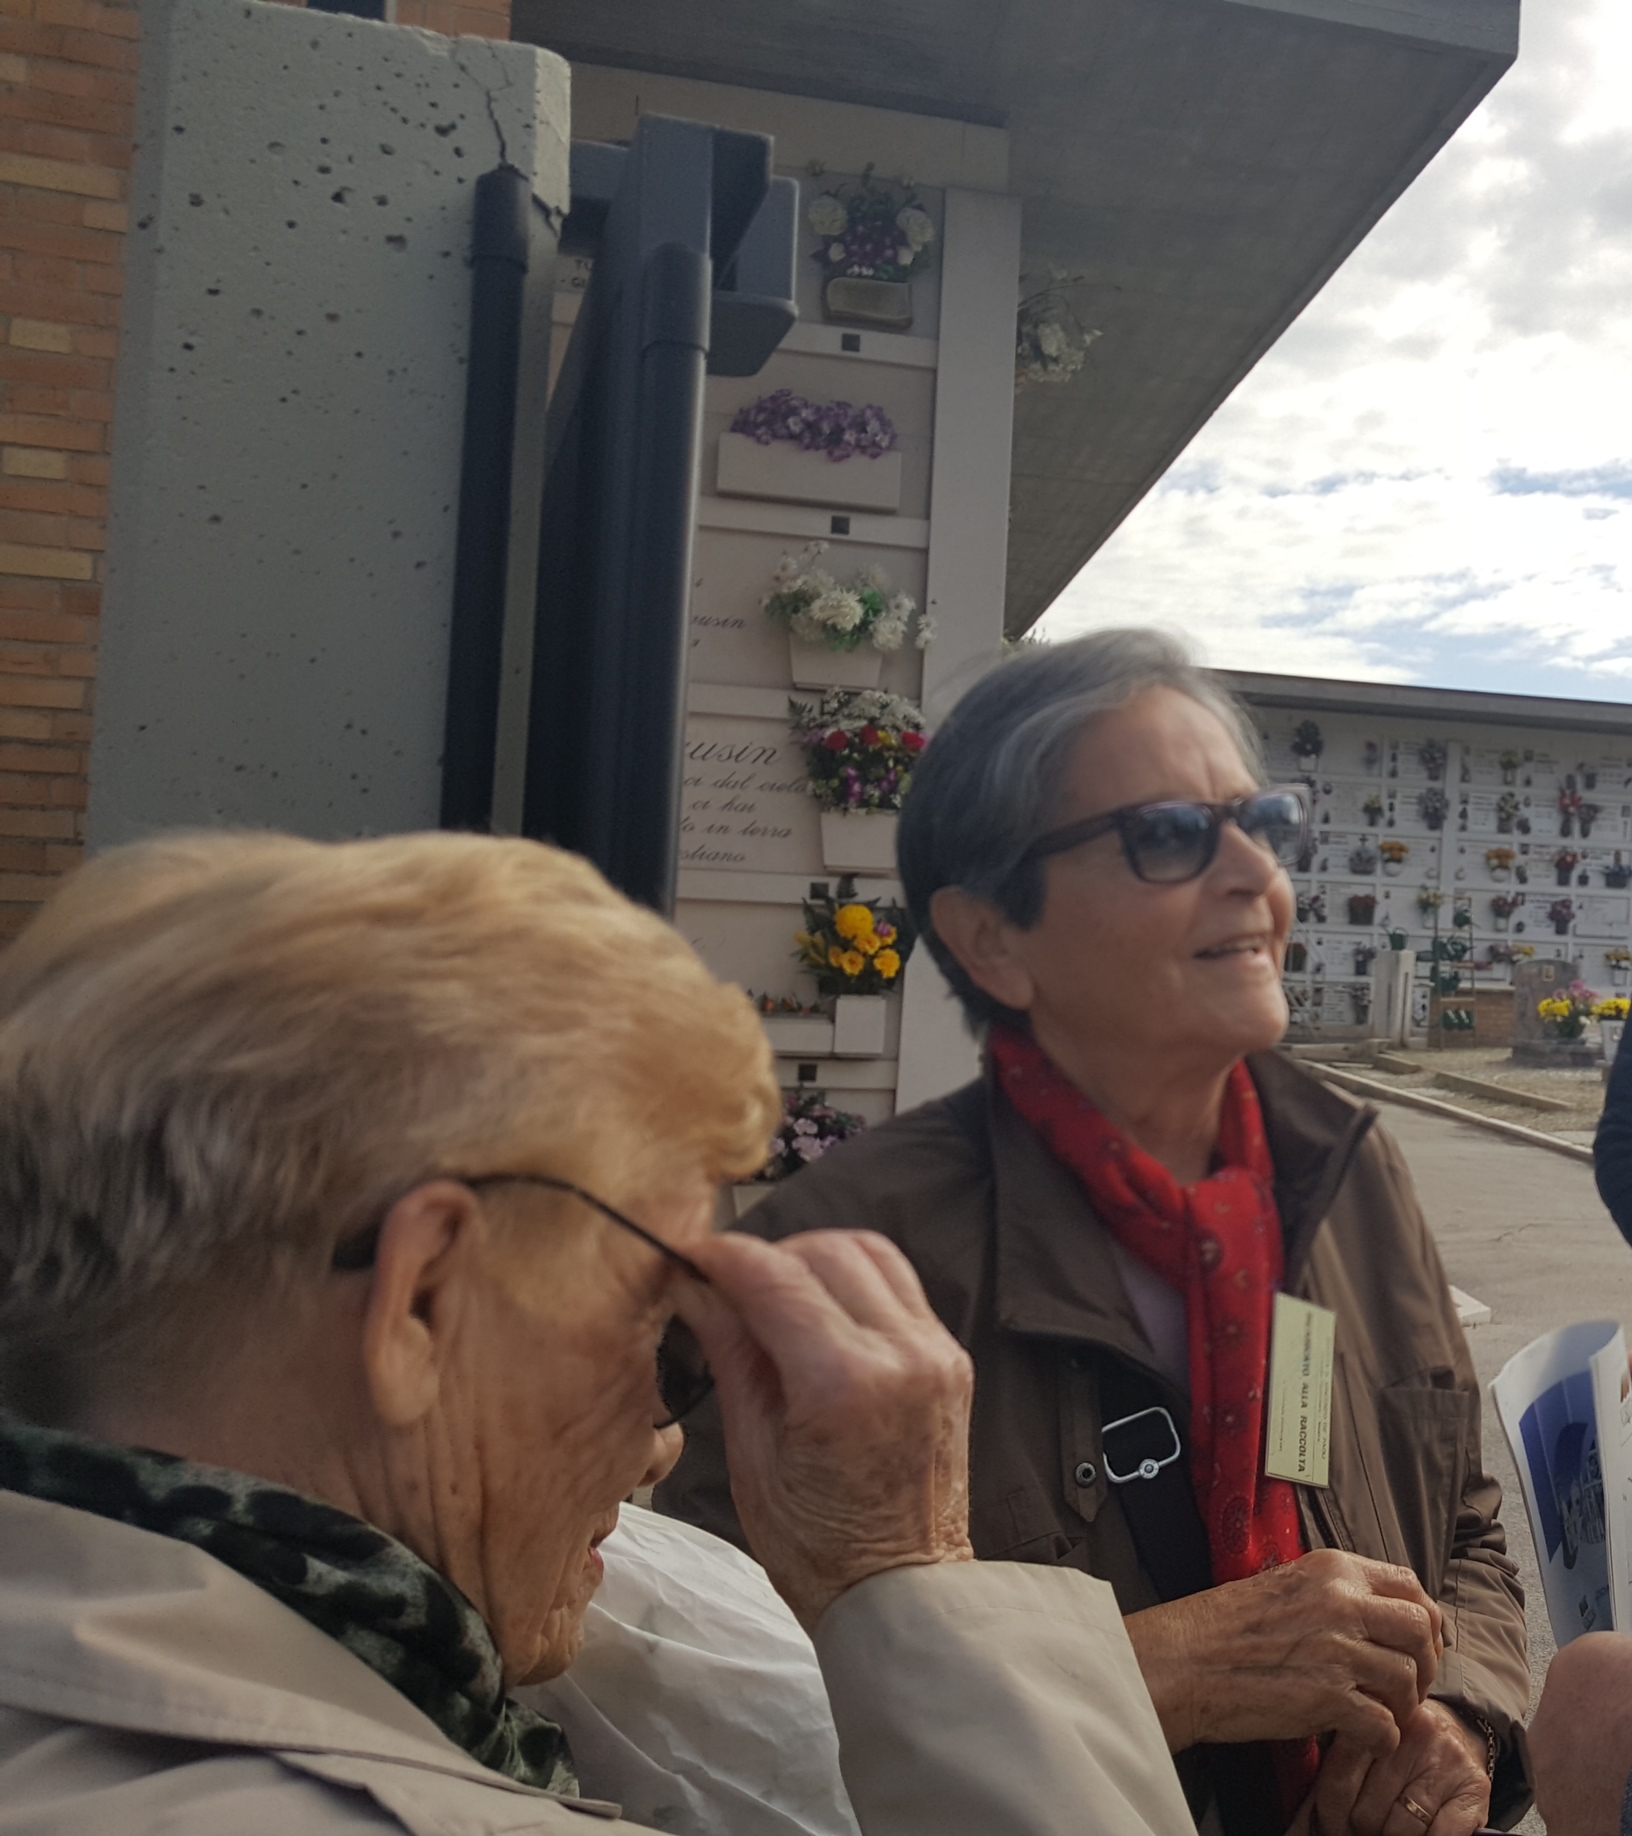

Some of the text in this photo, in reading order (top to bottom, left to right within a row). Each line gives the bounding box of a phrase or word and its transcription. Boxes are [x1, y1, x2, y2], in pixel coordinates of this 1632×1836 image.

[691, 614, 747, 629] usin
[685, 741, 780, 765] usin
[1301, 1382, 1309, 1409] ALLA
[1298, 1415, 1308, 1473] RACCOLTA
